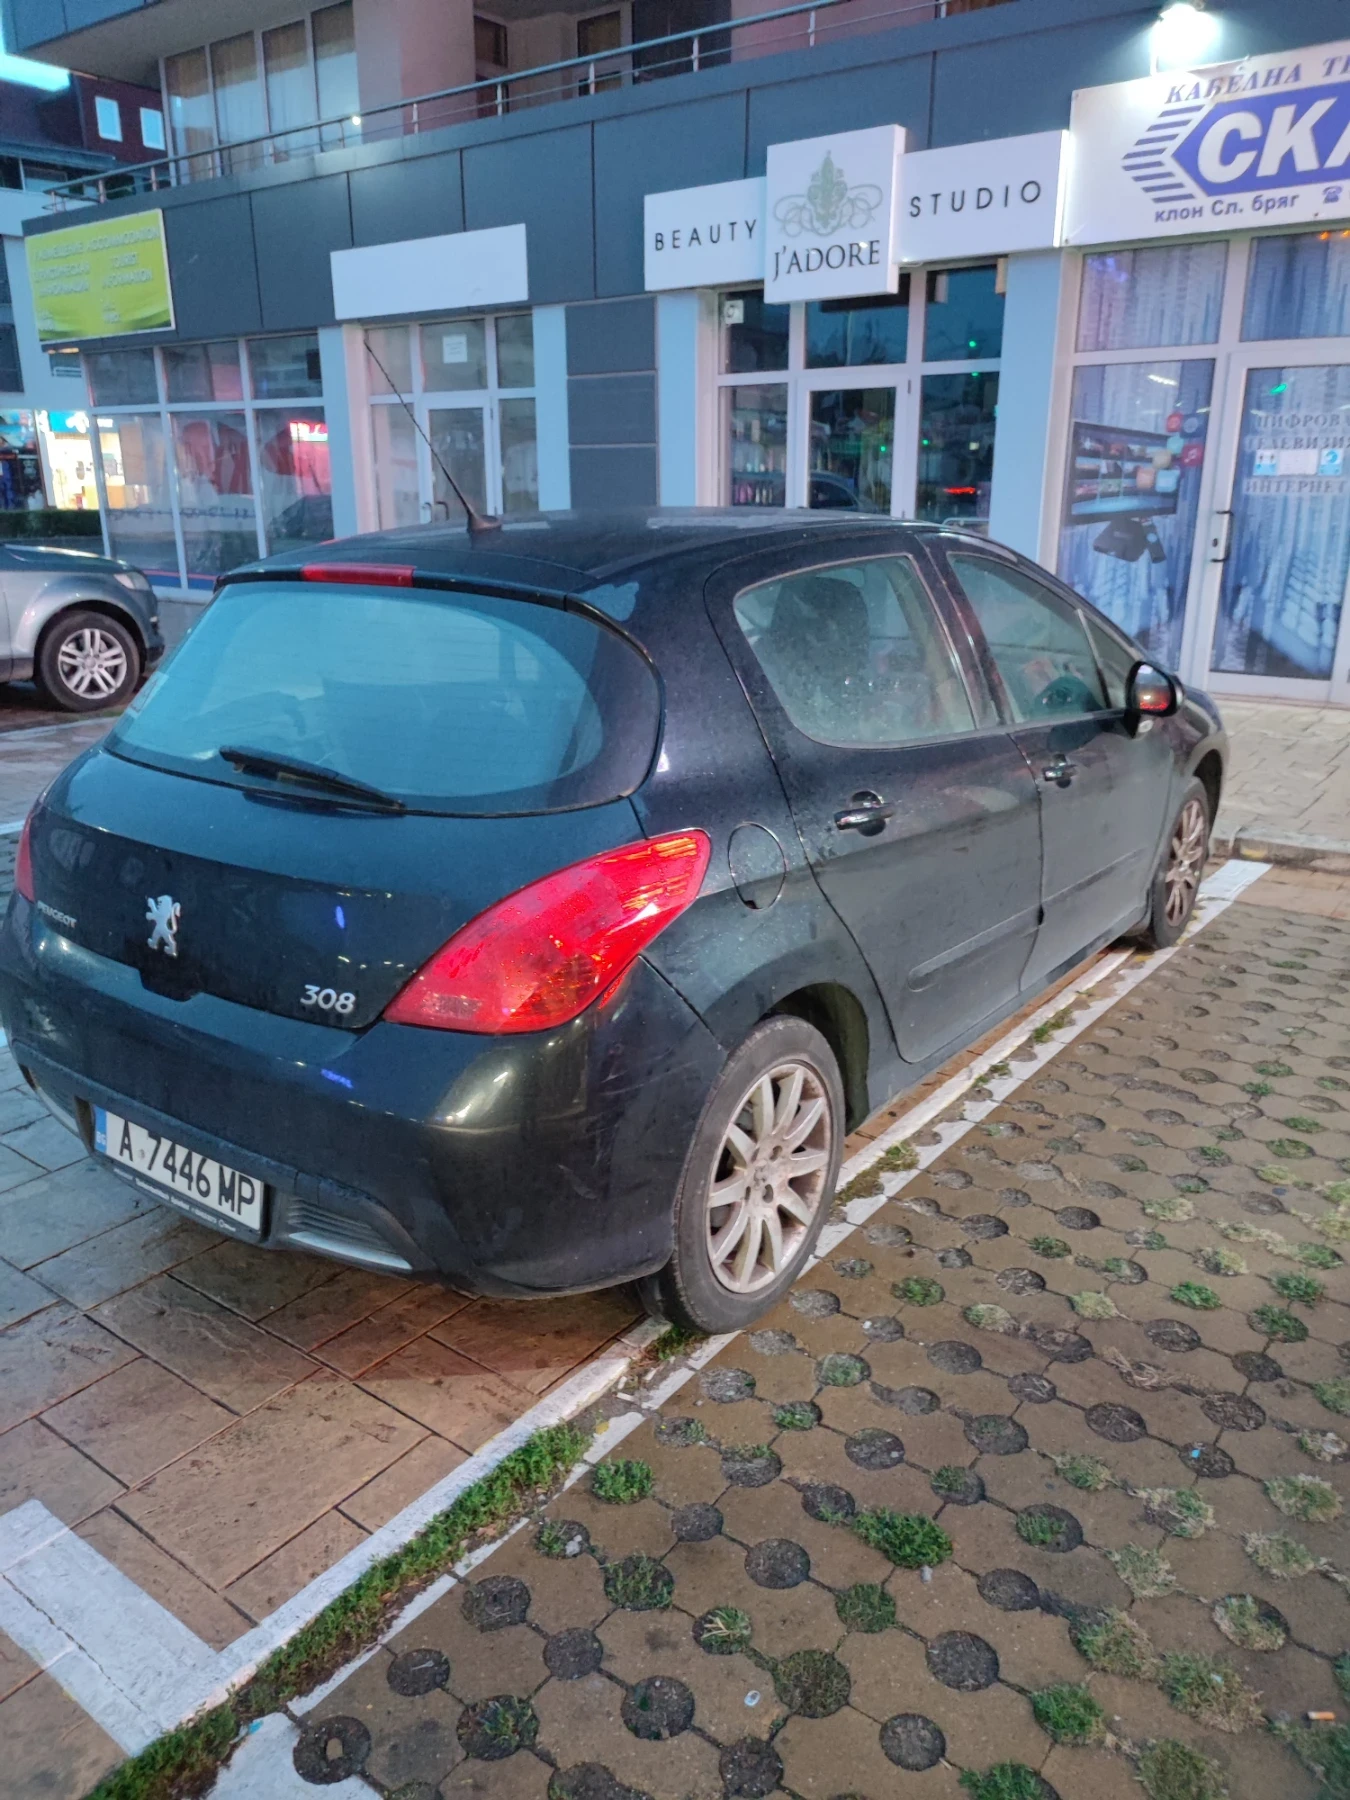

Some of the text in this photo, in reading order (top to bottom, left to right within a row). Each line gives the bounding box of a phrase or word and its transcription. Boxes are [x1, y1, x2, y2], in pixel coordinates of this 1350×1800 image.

[1165, 63, 1301, 104] КАБЕЛНА
[1197, 97, 1350, 184] СК
[909, 180, 1042, 218] STUDIO
[1155, 194, 1299, 222] клон Сл. бряг
[655, 219, 757, 251] BEAUTY
[300, 984, 355, 1014] 308
[147, 1130, 211, 1198] 7446
[218, 1163, 255, 1216] MP
